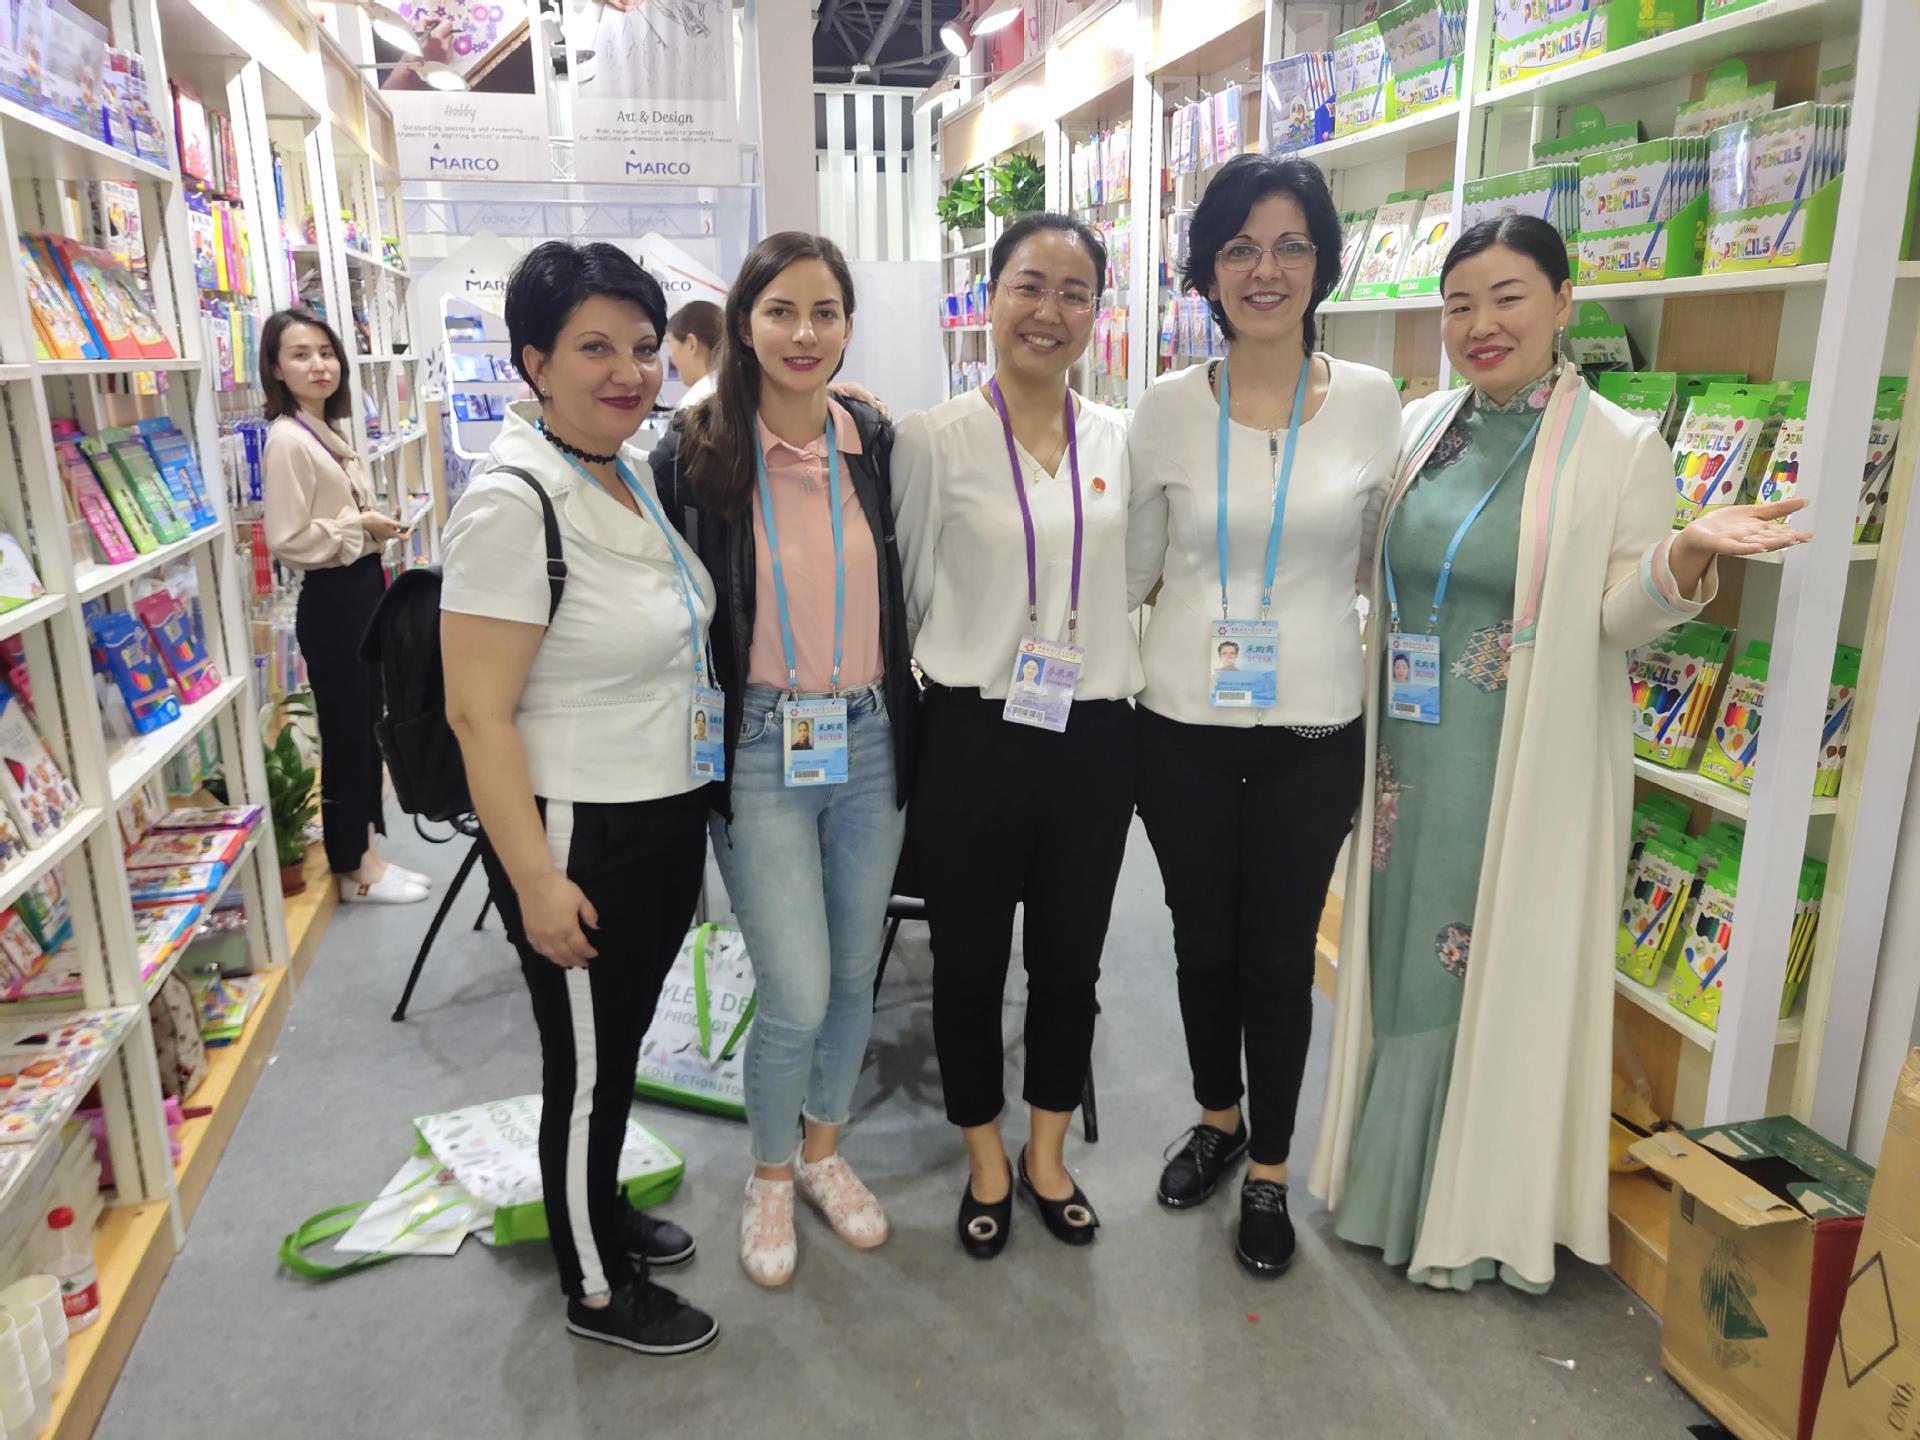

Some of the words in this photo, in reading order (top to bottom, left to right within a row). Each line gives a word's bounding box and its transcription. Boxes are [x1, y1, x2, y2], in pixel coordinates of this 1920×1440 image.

[1400, 32, 1436, 59] PENCILS
[1539, 30, 1581, 61] PENCILS
[1356, 51, 1380, 66] PENCILS
[1410, 85, 1439, 104] PENCILS
[444, 103, 477, 123] Hobby
[617, 111, 636, 123] Art
[639, 111, 649, 124] &
[652, 111, 694, 126] Design
[1346, 109, 1370, 125] PENCILS
[430, 156, 499, 171] MARCO
[625, 161, 691, 175] MARCO
[1754, 146, 1801, 171] PENCILS
[1598, 186, 1650, 214] PENCILS
[1723, 236, 1770, 259] PENCILS
[1599, 251, 1640, 271] PENCILS
[466, 279, 508, 292] MAR
[660, 280, 692, 292] RCO
[1684, 433, 1735, 452] PENCILS
[1765, 483, 1773, 492] 24
[1629, 660, 1681, 686] PENCILS
[1732, 689, 1763, 707] PENCIL
[1706, 901, 1734, 923] PENCIL
[662, 983, 695, 1005] YLE
[665, 1010, 738, 1035] PRODCTS
